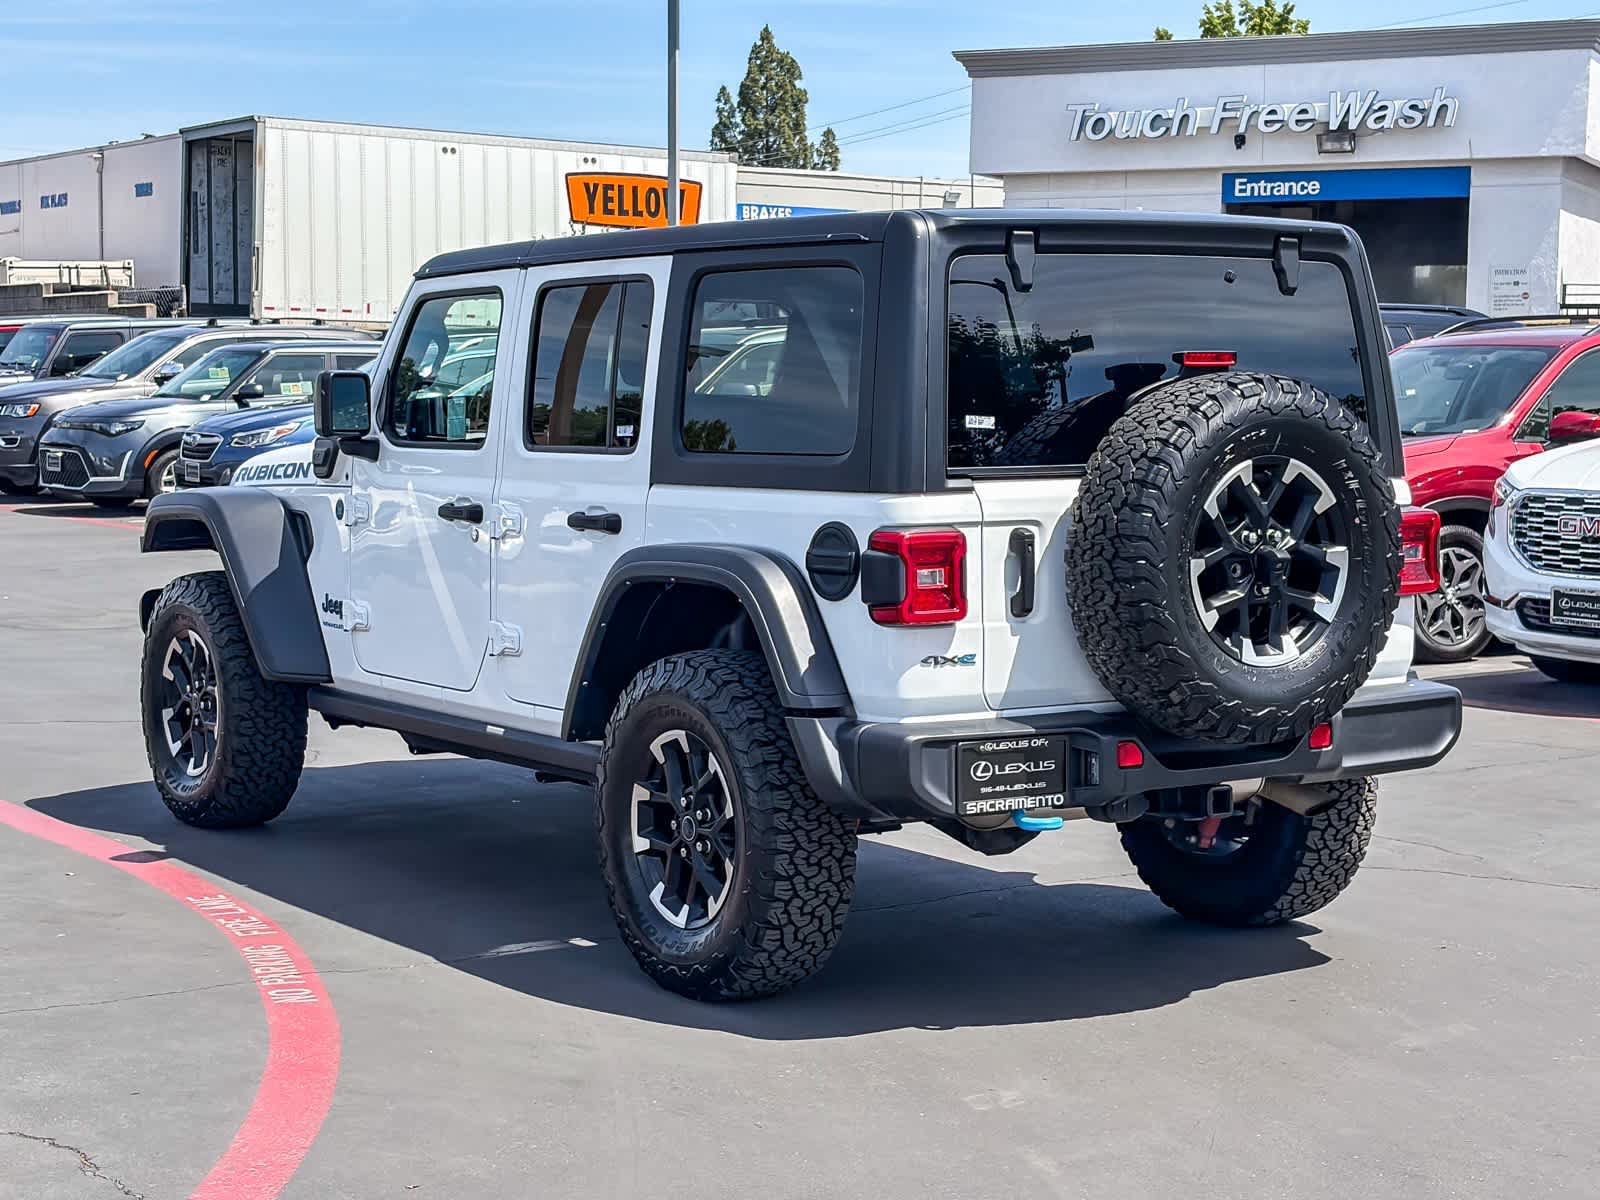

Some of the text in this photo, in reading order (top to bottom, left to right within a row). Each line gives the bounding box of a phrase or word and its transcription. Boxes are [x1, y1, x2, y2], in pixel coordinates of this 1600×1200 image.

[1066, 86, 1460, 142] Touch Free Wash
[1233, 178, 1321, 197] Entrance
[235, 462, 312, 483] RUBICON
[321, 592, 344, 620] Jeep
[993, 740, 1030, 750] LEXUS
[994, 760, 1056, 775] LEXUS
[965, 794, 1065, 814] SACRAMENTO
[185, 894, 319, 1004] NO PARKING FIRE LANE
